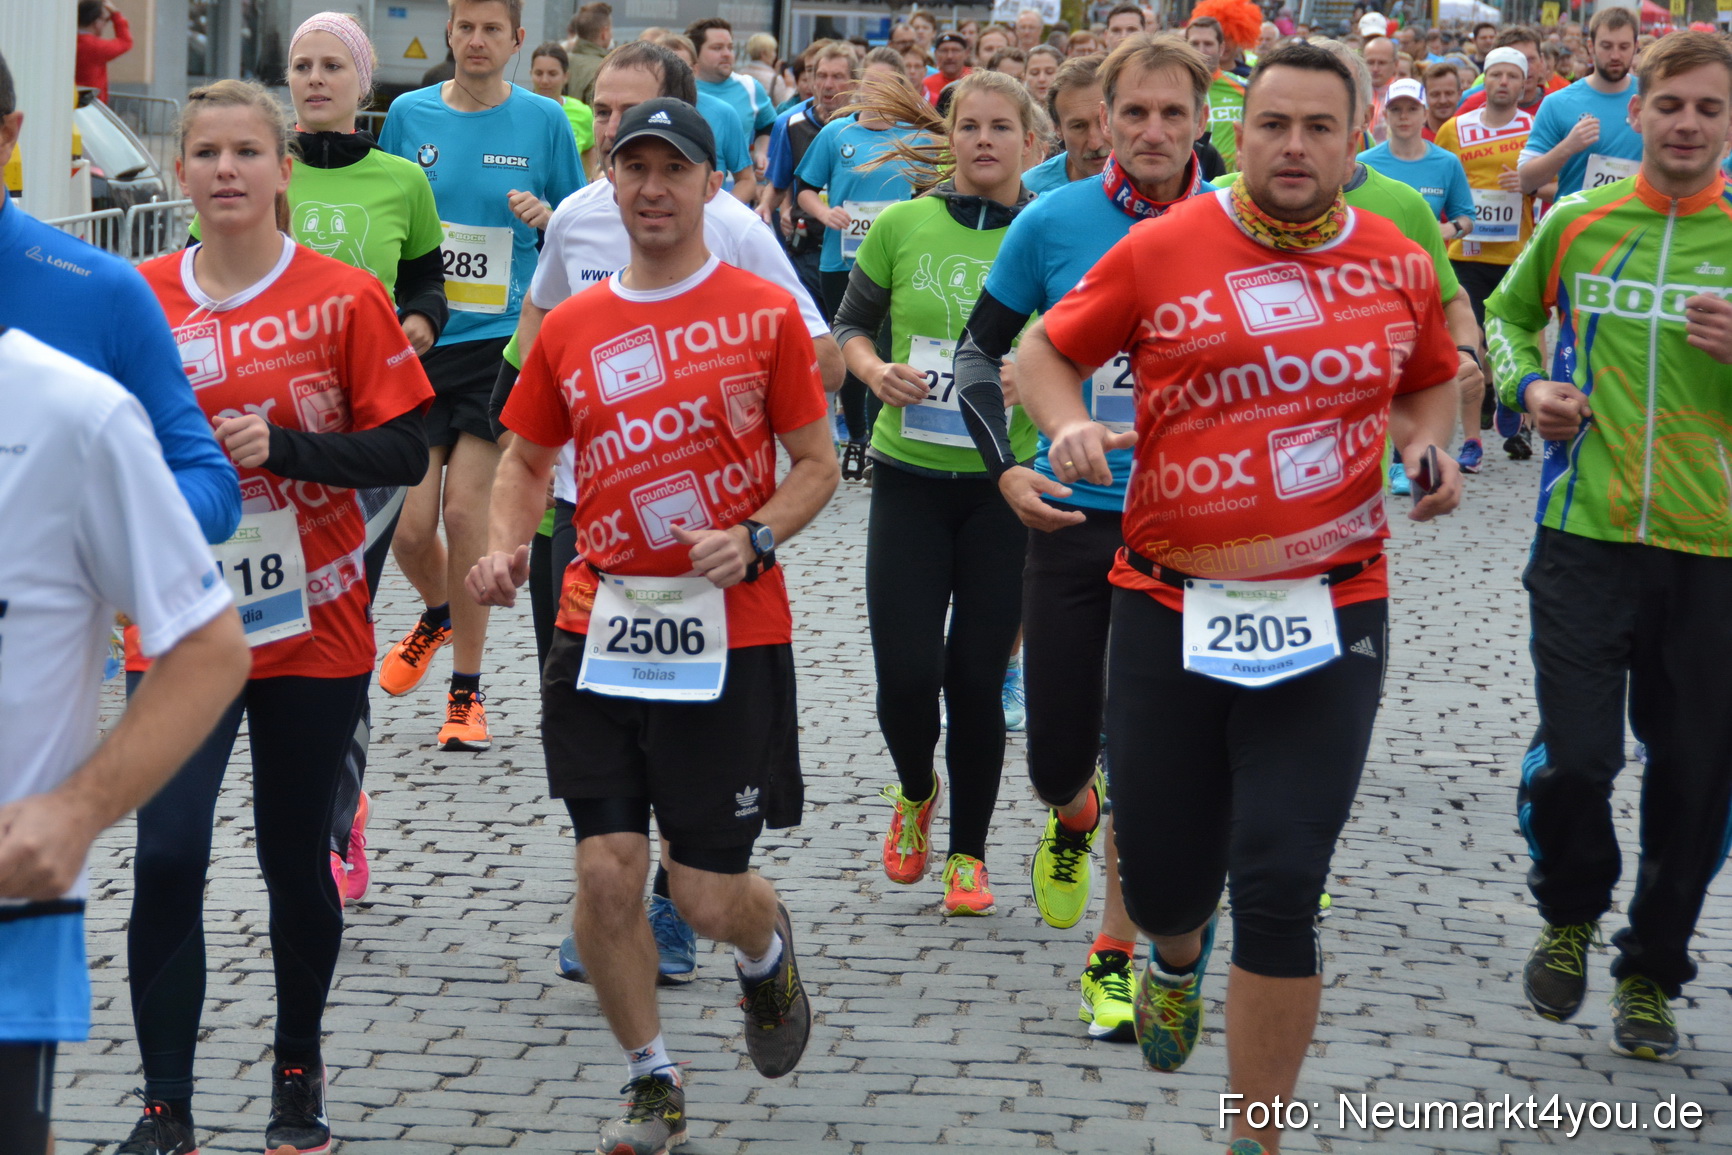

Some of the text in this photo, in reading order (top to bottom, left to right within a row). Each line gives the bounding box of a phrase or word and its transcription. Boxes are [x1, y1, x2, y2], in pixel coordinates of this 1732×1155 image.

[483, 154, 529, 168] BOCK
[1460, 146, 1494, 161] MAX
[1474, 206, 1513, 222] 2610
[456, 232, 486, 242] BOCK
[850, 219, 875, 236] 29
[46, 255, 92, 277] Löffler
[442, 250, 488, 278] 283
[1232, 266, 1300, 290] raumbox
[1314, 252, 1435, 303] raum
[1333, 299, 1402, 322] schenken
[230, 295, 354, 357] raum
[665, 307, 787, 361] raum
[596, 332, 651, 362] raumbox
[1164, 330, 1227, 360] outdoor
[236, 347, 316, 377] schenken
[673, 351, 745, 380] schenken
[1148, 341, 1382, 418] raumbox
[1230, 402, 1300, 428] wohnen
[1315, 384, 1381, 408] outdoor
[1274, 426, 1336, 449] raumbox
[602, 435, 720, 489] wohnen outdoor
[636, 476, 693, 506] raumbox
[1188, 495, 1257, 517] outdoor
[231, 527, 261, 540] CK
[1284, 512, 1365, 560] raumbox
[1146, 533, 1279, 574] Team
[218, 553, 285, 597] 18
[636, 590, 683, 601] BOCK
[606, 615, 705, 655] 2506
[1206, 613, 1312, 653] 2505
[593, 646, 599, 654] D
[1349, 645, 1377, 658] adidas
[632, 667, 676, 681] Tobias
[1231, 659, 1294, 674] Andreas
[735, 805, 759, 817] adidas
